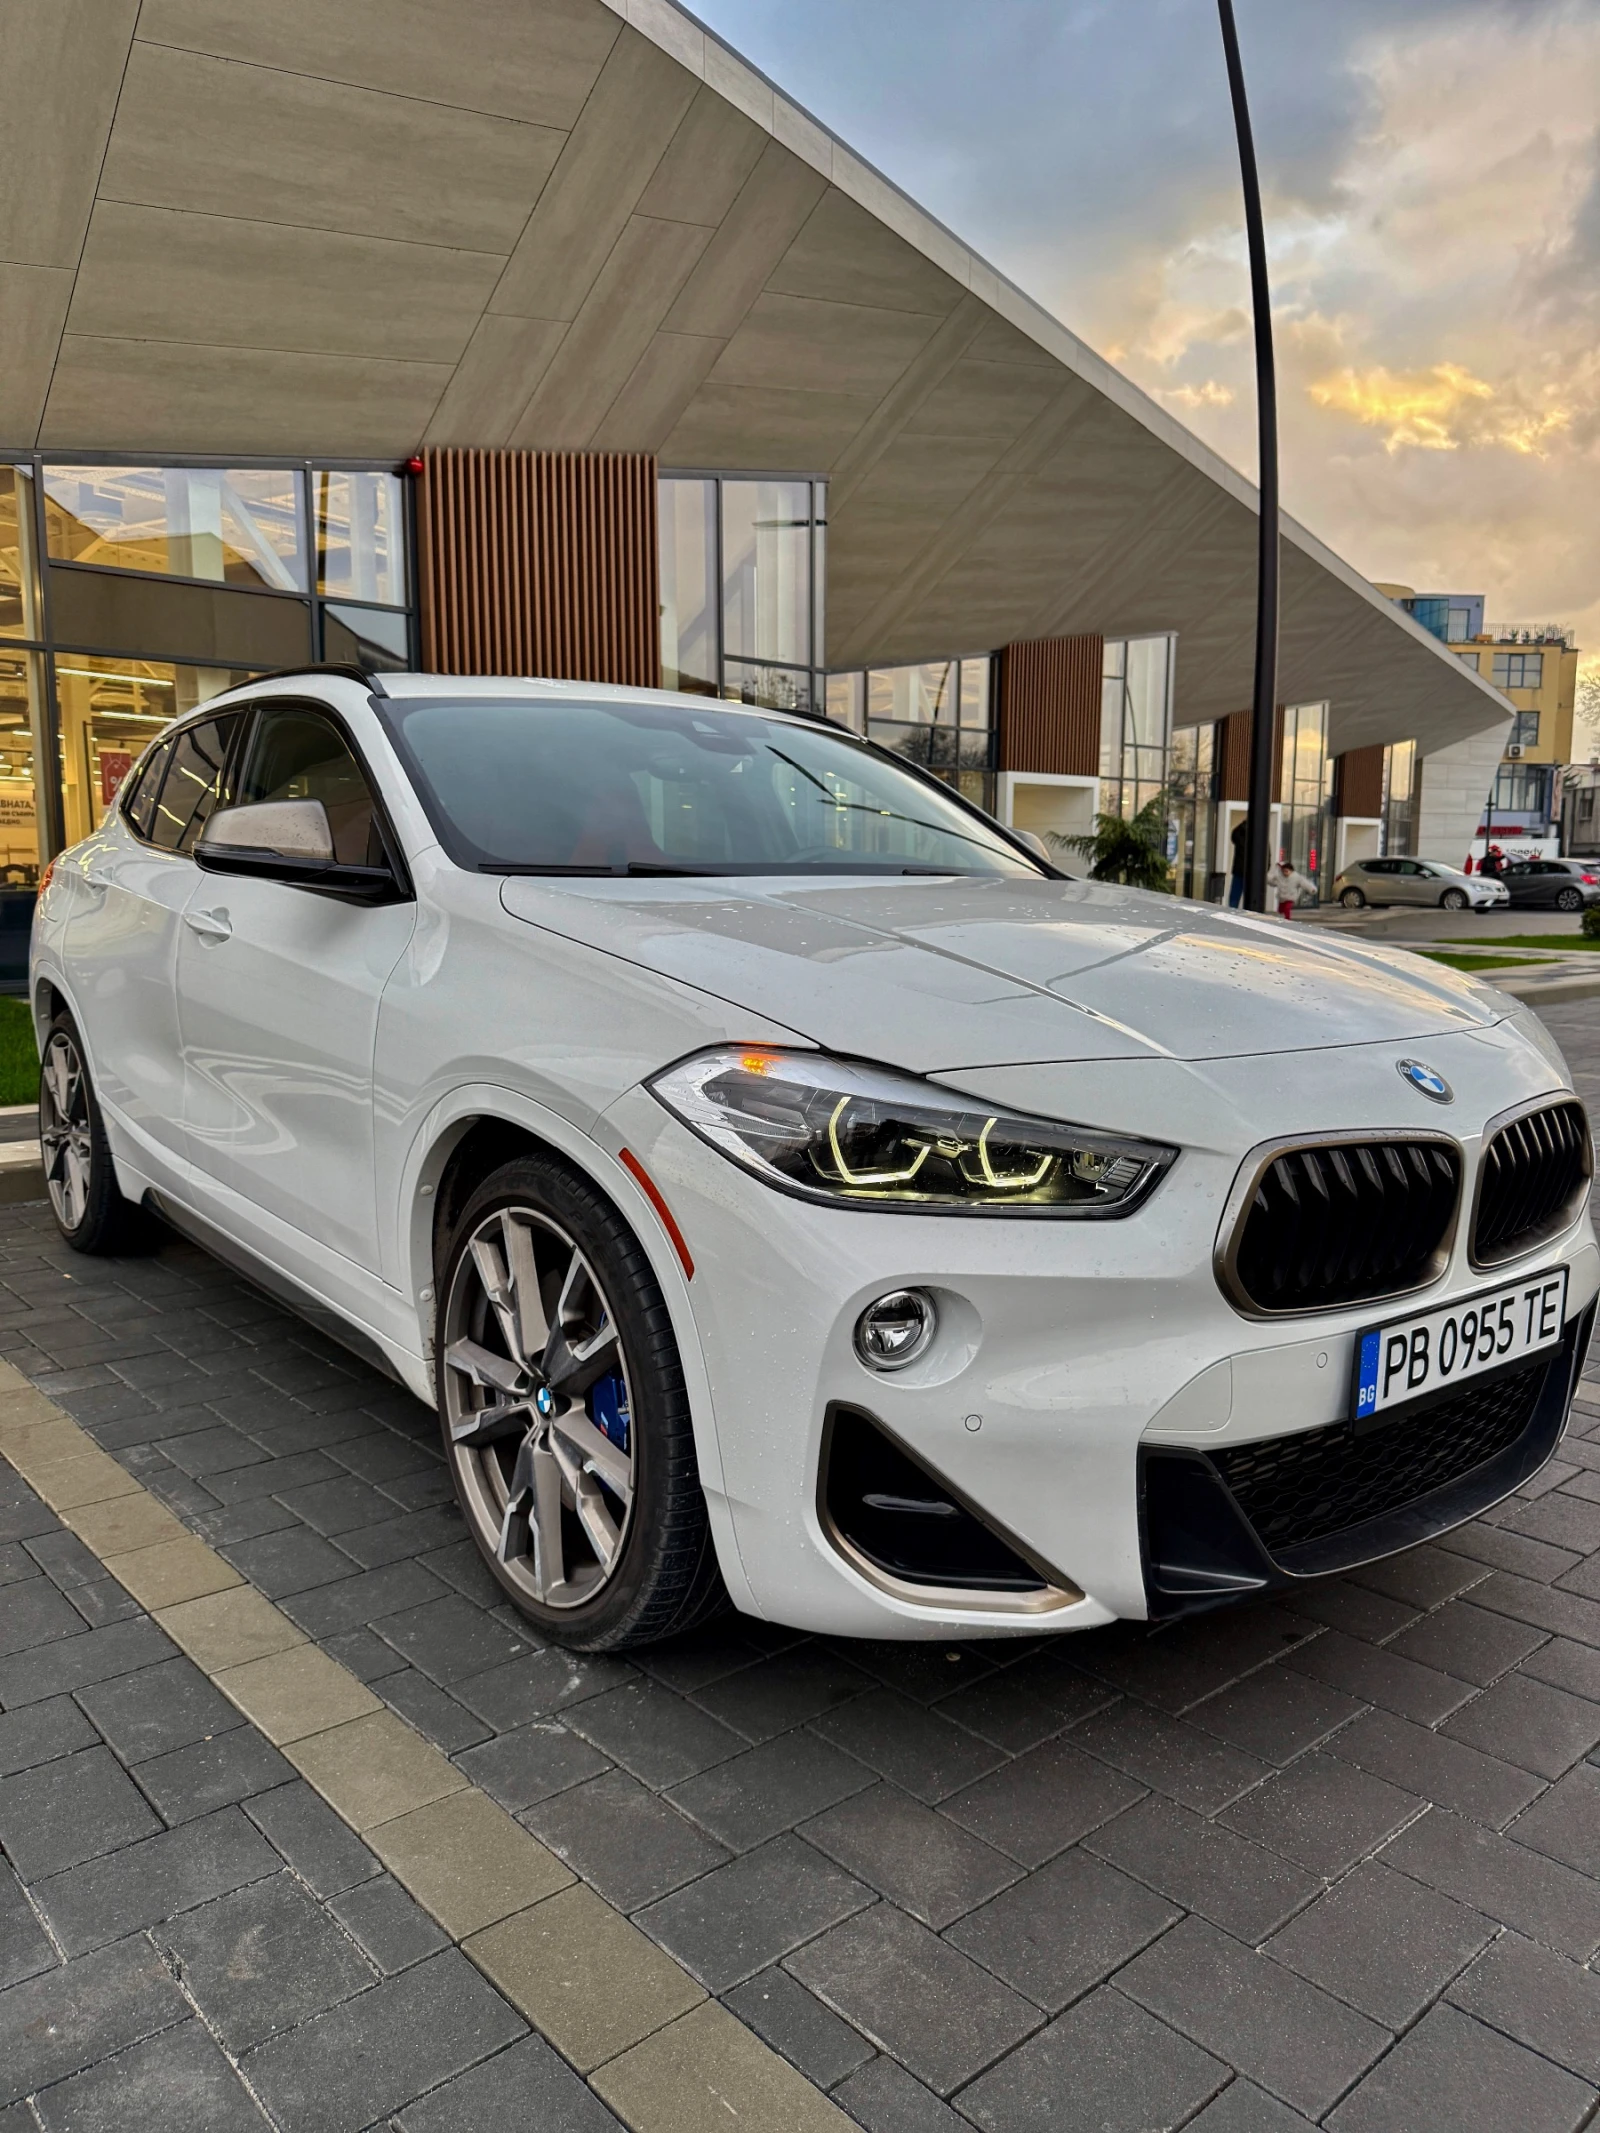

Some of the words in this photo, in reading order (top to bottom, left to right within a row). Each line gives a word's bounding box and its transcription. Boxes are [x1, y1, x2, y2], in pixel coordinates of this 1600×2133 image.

[0, 799, 34, 810] ВНАТА,
[1383, 1325, 1430, 1399] PB
[1439, 1296, 1515, 1376] 0955
[1524, 1280, 1560, 1345] TE
[1358, 1384, 1376, 1407] BG
